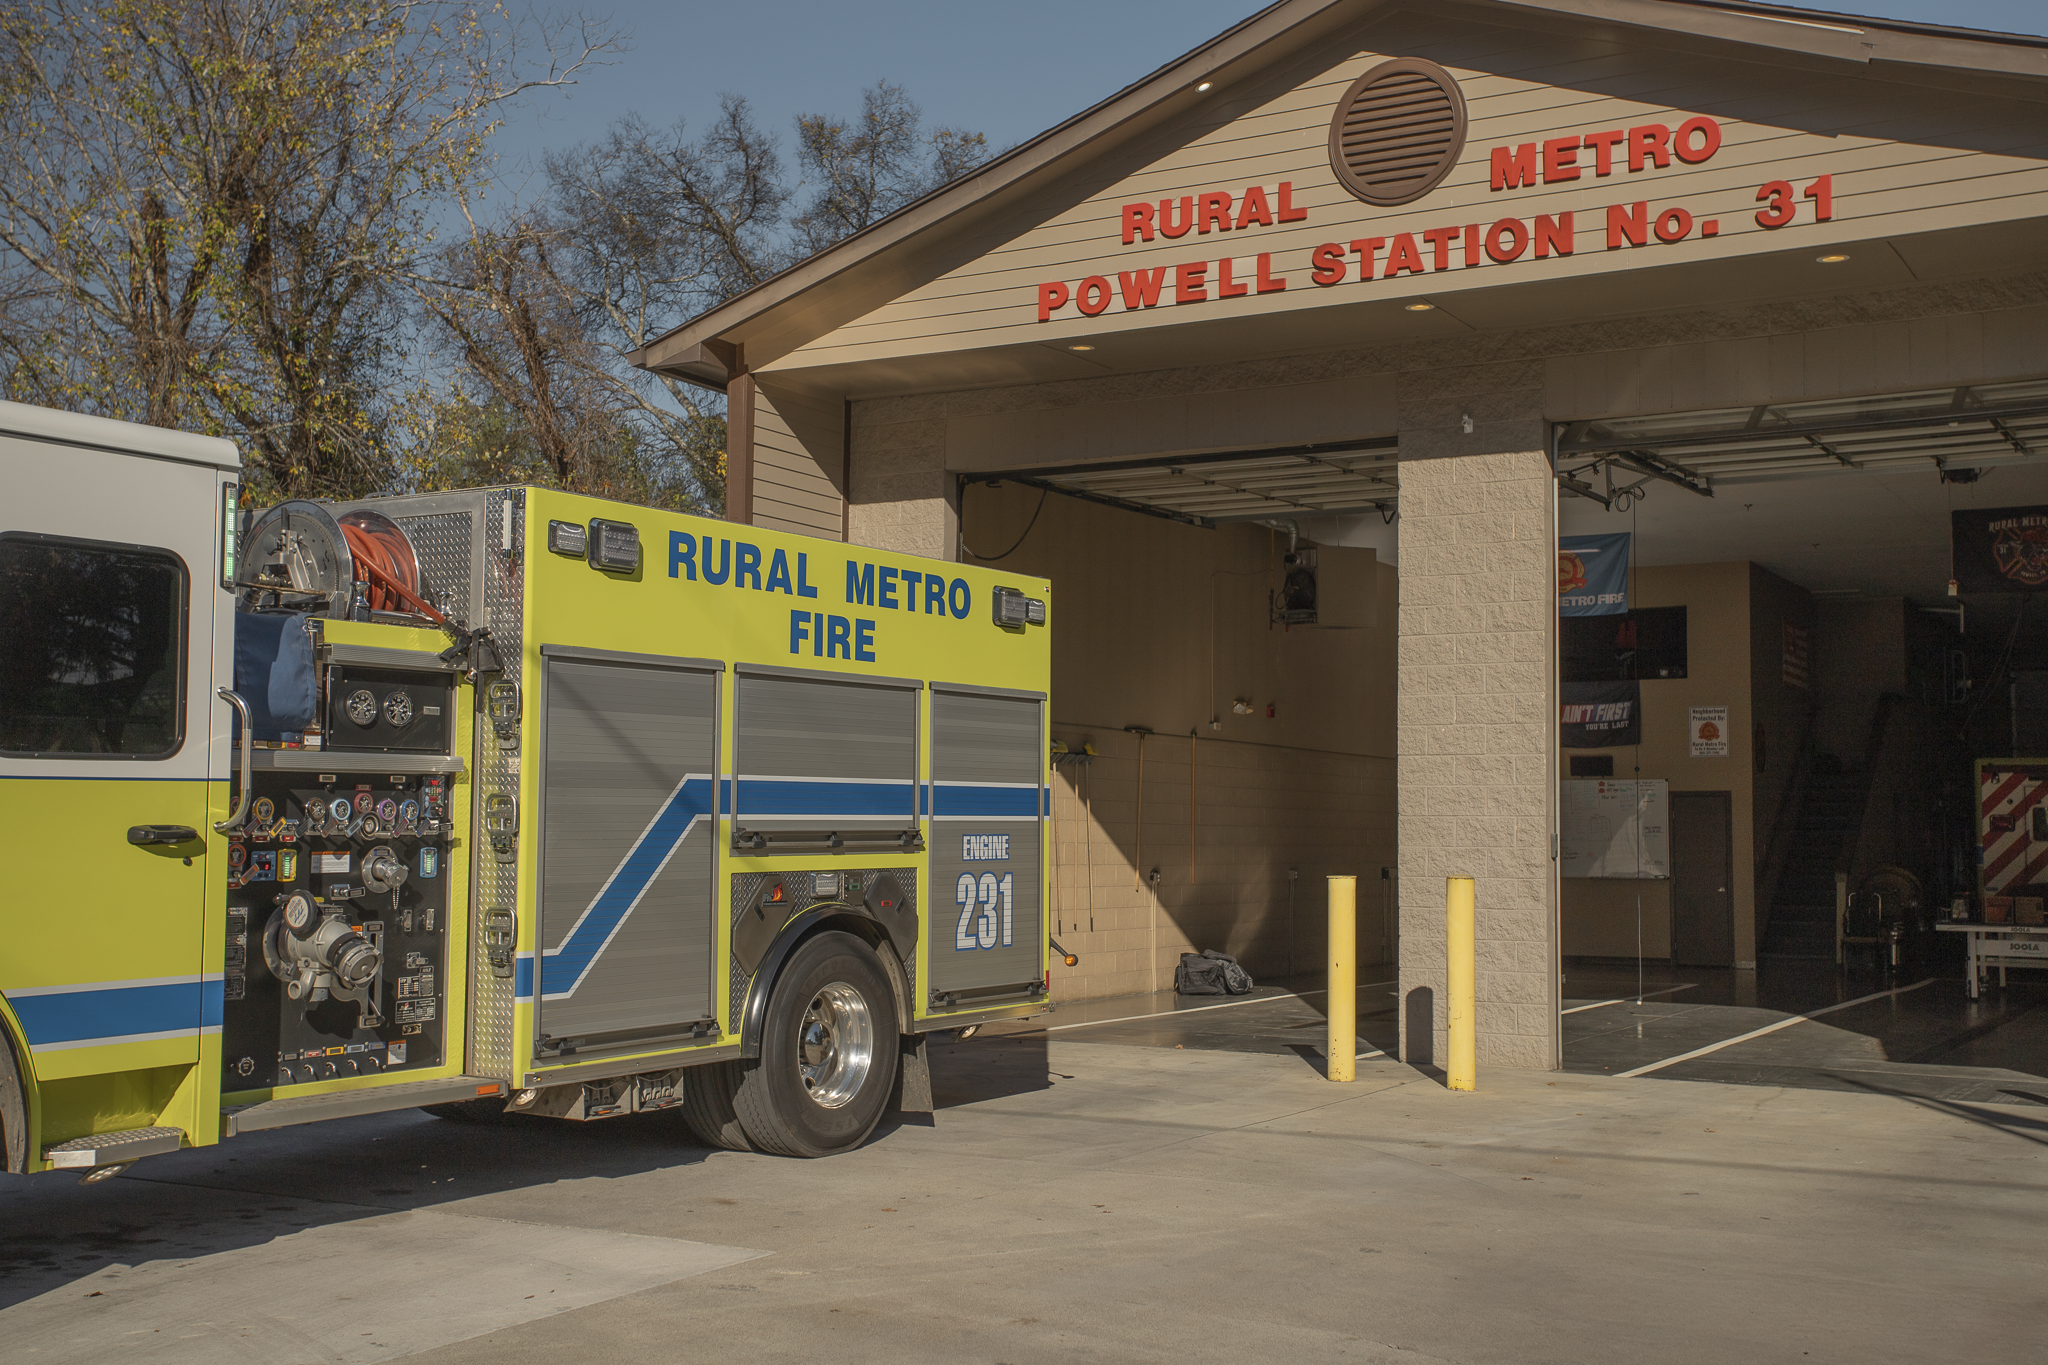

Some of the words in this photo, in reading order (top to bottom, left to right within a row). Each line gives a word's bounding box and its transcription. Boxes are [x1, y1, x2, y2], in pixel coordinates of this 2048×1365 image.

[1121, 181, 1308, 246] RURAL
[1490, 115, 1722, 192] METRO
[1037, 252, 1287, 322] POWELL
[1311, 211, 1574, 286] STATION
[1606, 199, 1719, 252] No.
[1755, 174, 1833, 230] 31
[1989, 518, 2017, 533] RURAL
[2023, 517, 2048, 527] METR
[668, 530, 818, 598] RURAL
[846, 560, 971, 620] METRO
[1598, 593, 1624, 604] FIRE
[790, 610, 876, 663] FIRE
[1561, 705, 1594, 722] AIN'T
[1595, 702, 1630, 722] FIRST
[962, 833, 1009, 861] ENGINE
[956, 871, 1013, 951] 231
